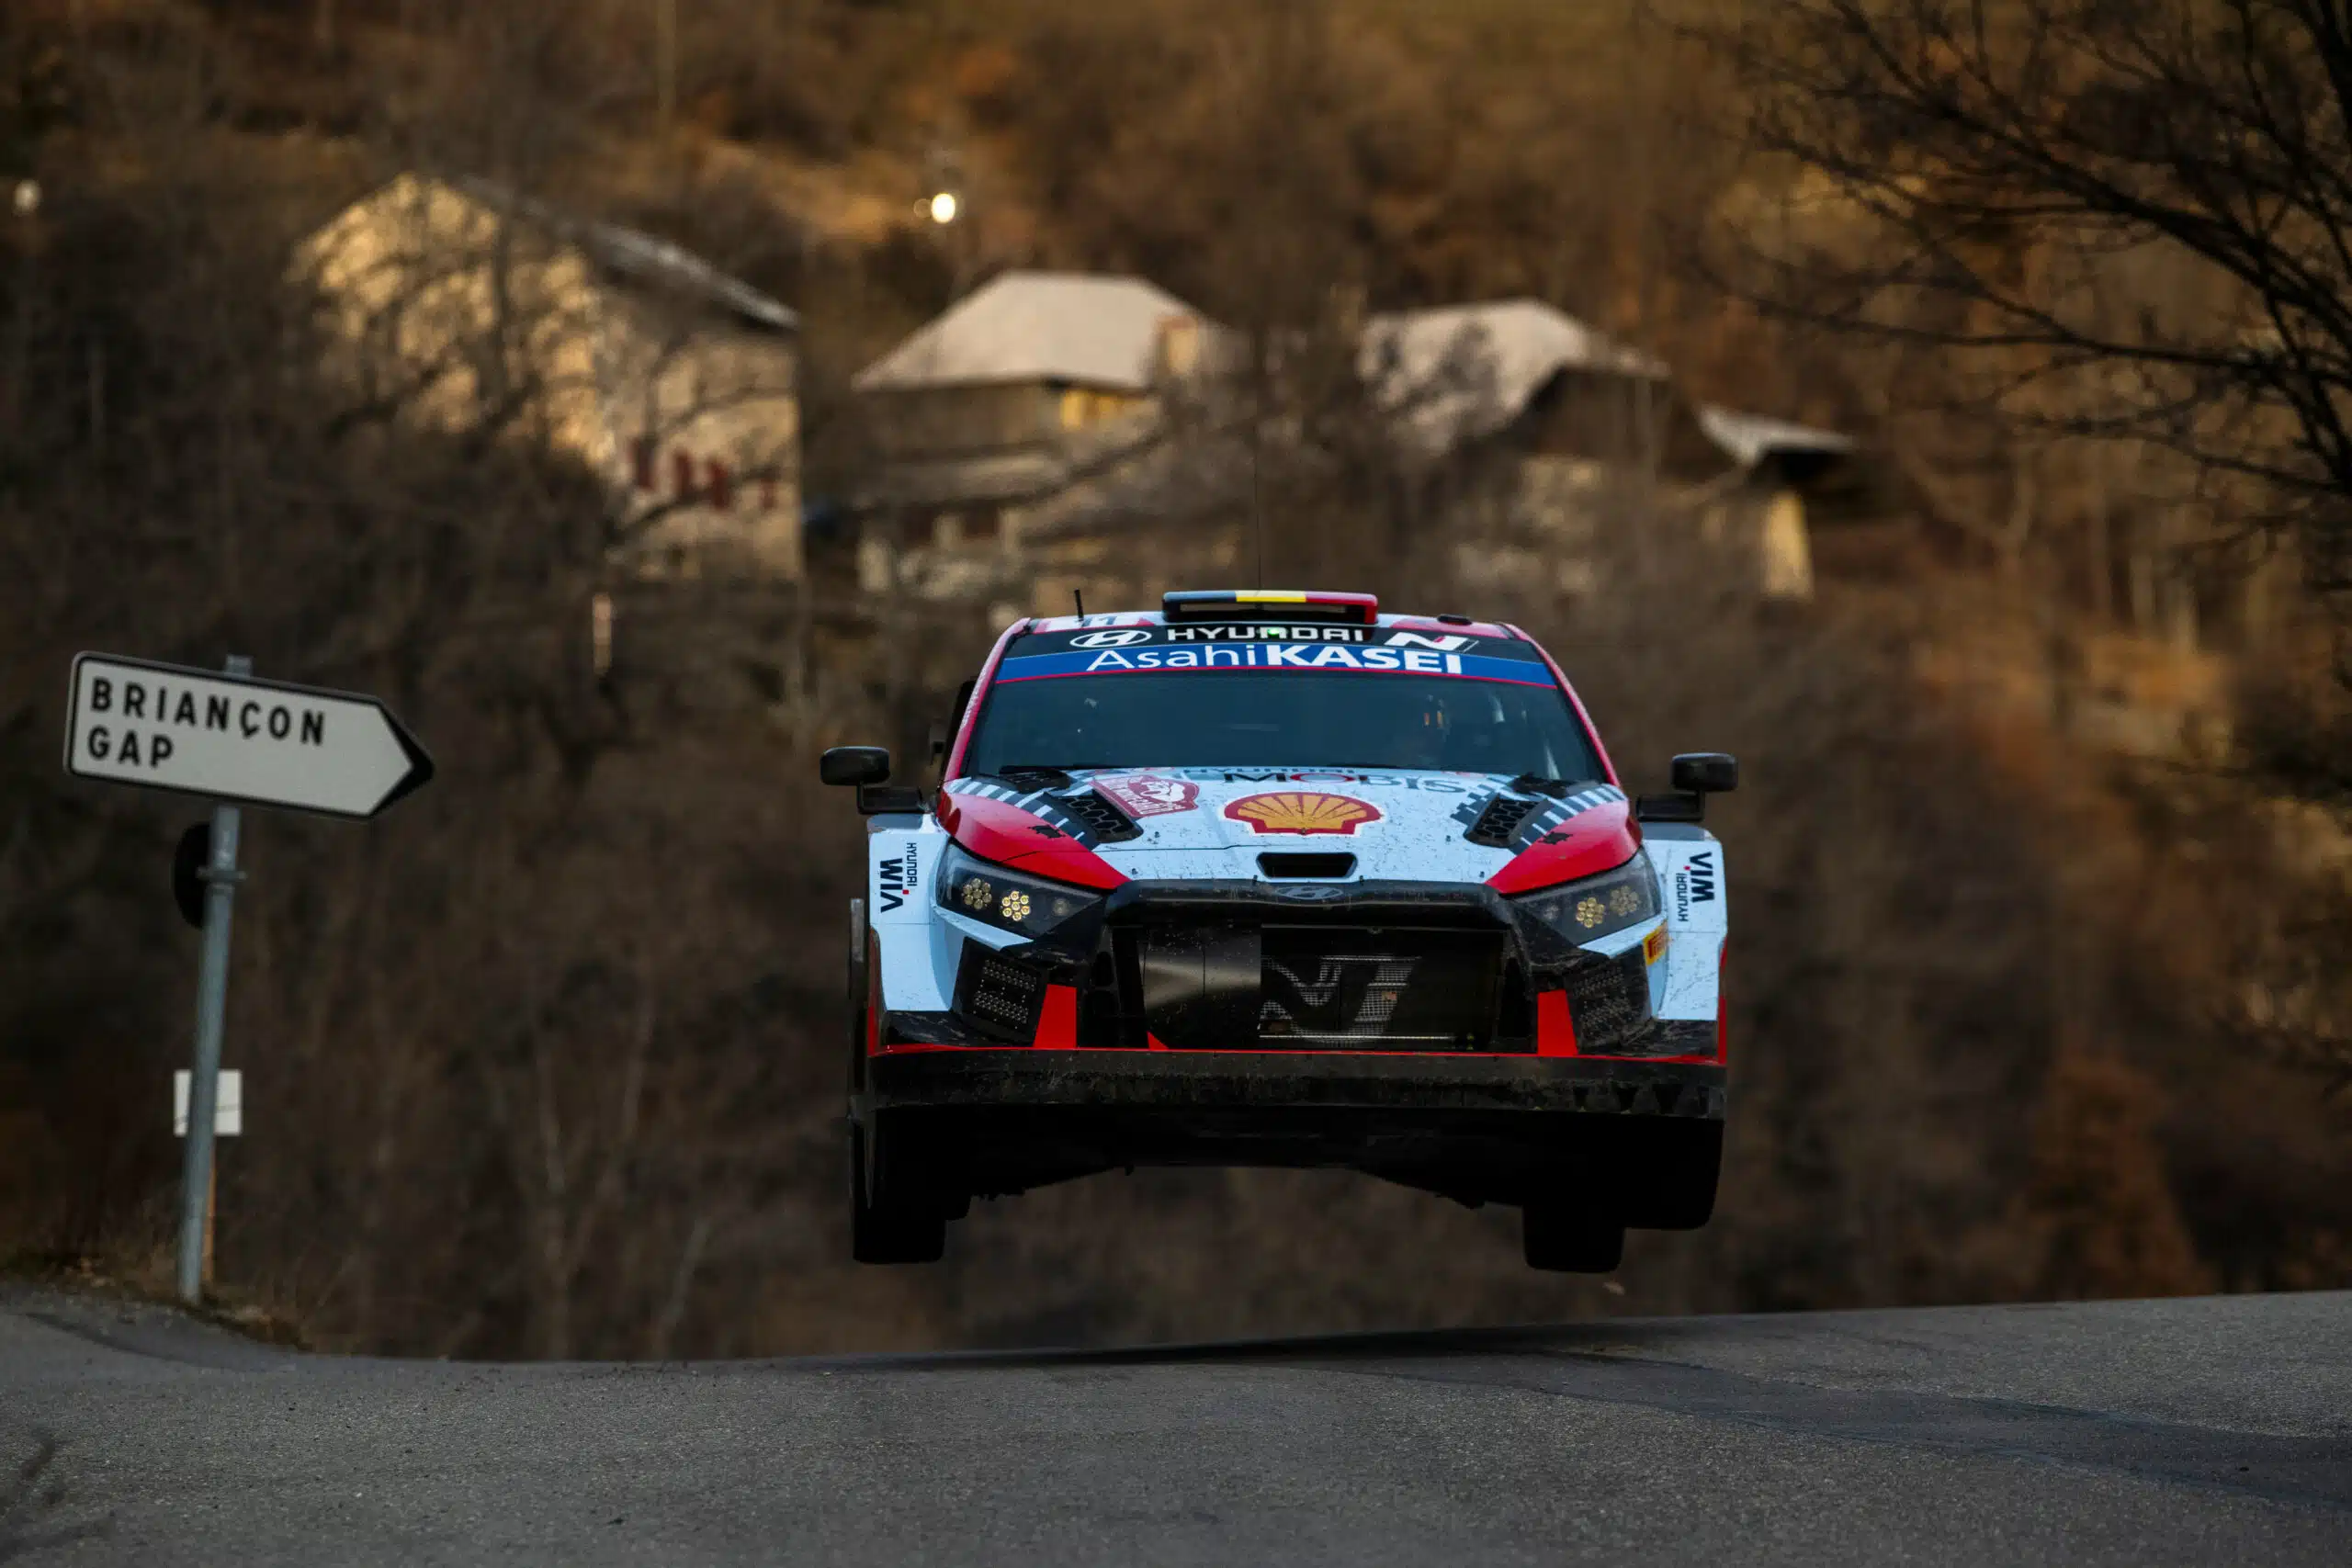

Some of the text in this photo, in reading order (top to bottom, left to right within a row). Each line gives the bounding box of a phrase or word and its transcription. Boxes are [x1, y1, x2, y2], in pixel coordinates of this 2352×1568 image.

[1167, 626, 1364, 642] HYUNDAI
[90, 676, 325, 747] BRIANÇON
[88, 726, 174, 769] GAP
[1223, 772, 1467, 794] MOBIS
[906, 842, 918, 886] HYUNDAI
[1676, 872, 1690, 922] HYUNDAI
